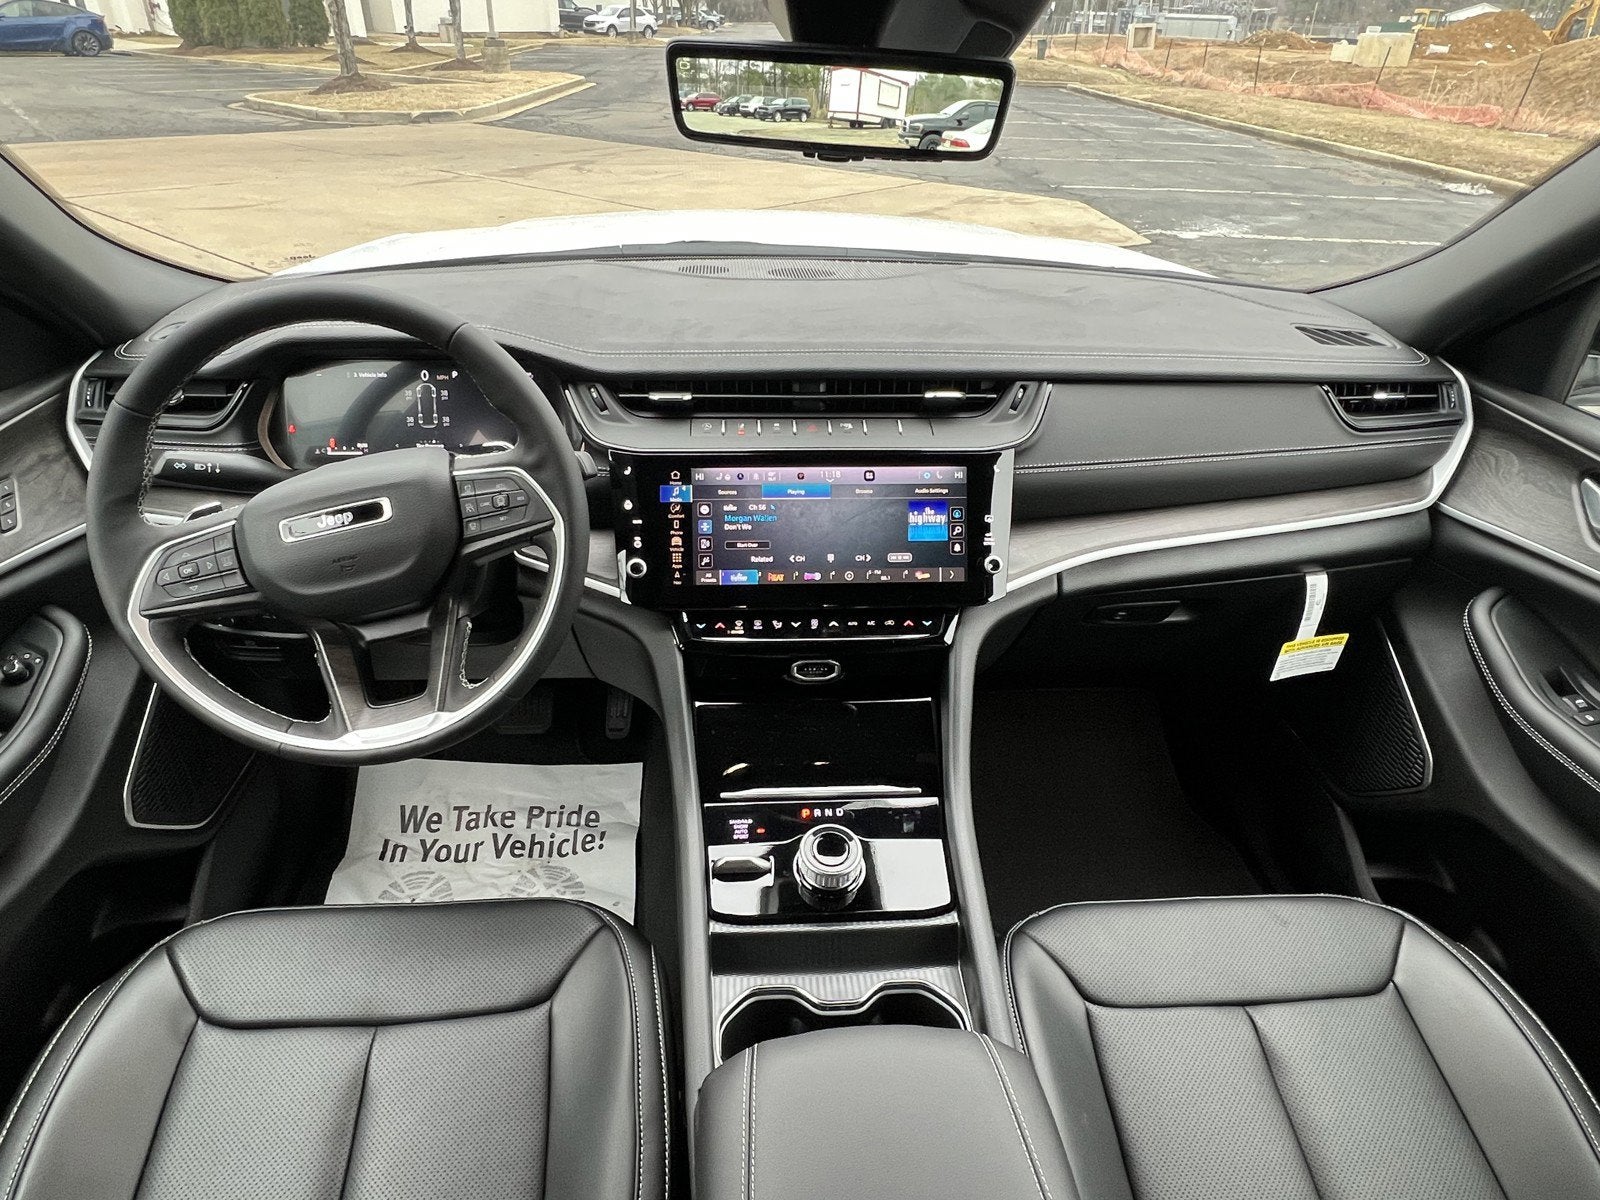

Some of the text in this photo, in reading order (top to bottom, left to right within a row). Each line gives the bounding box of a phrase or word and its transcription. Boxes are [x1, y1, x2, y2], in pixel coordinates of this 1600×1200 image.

[421, 370, 429, 381] 0
[317, 511, 354, 529] Jeep
[724, 515, 752, 524] Morgan
[908, 511, 946, 526] highway
[750, 555, 774, 563] Related
[399, 804, 601, 833] We Take Pride
[801, 808, 811, 818] P
[824, 808, 832, 817] N
[835, 807, 844, 816] D
[378, 829, 607, 863] In Your Vehicle!
